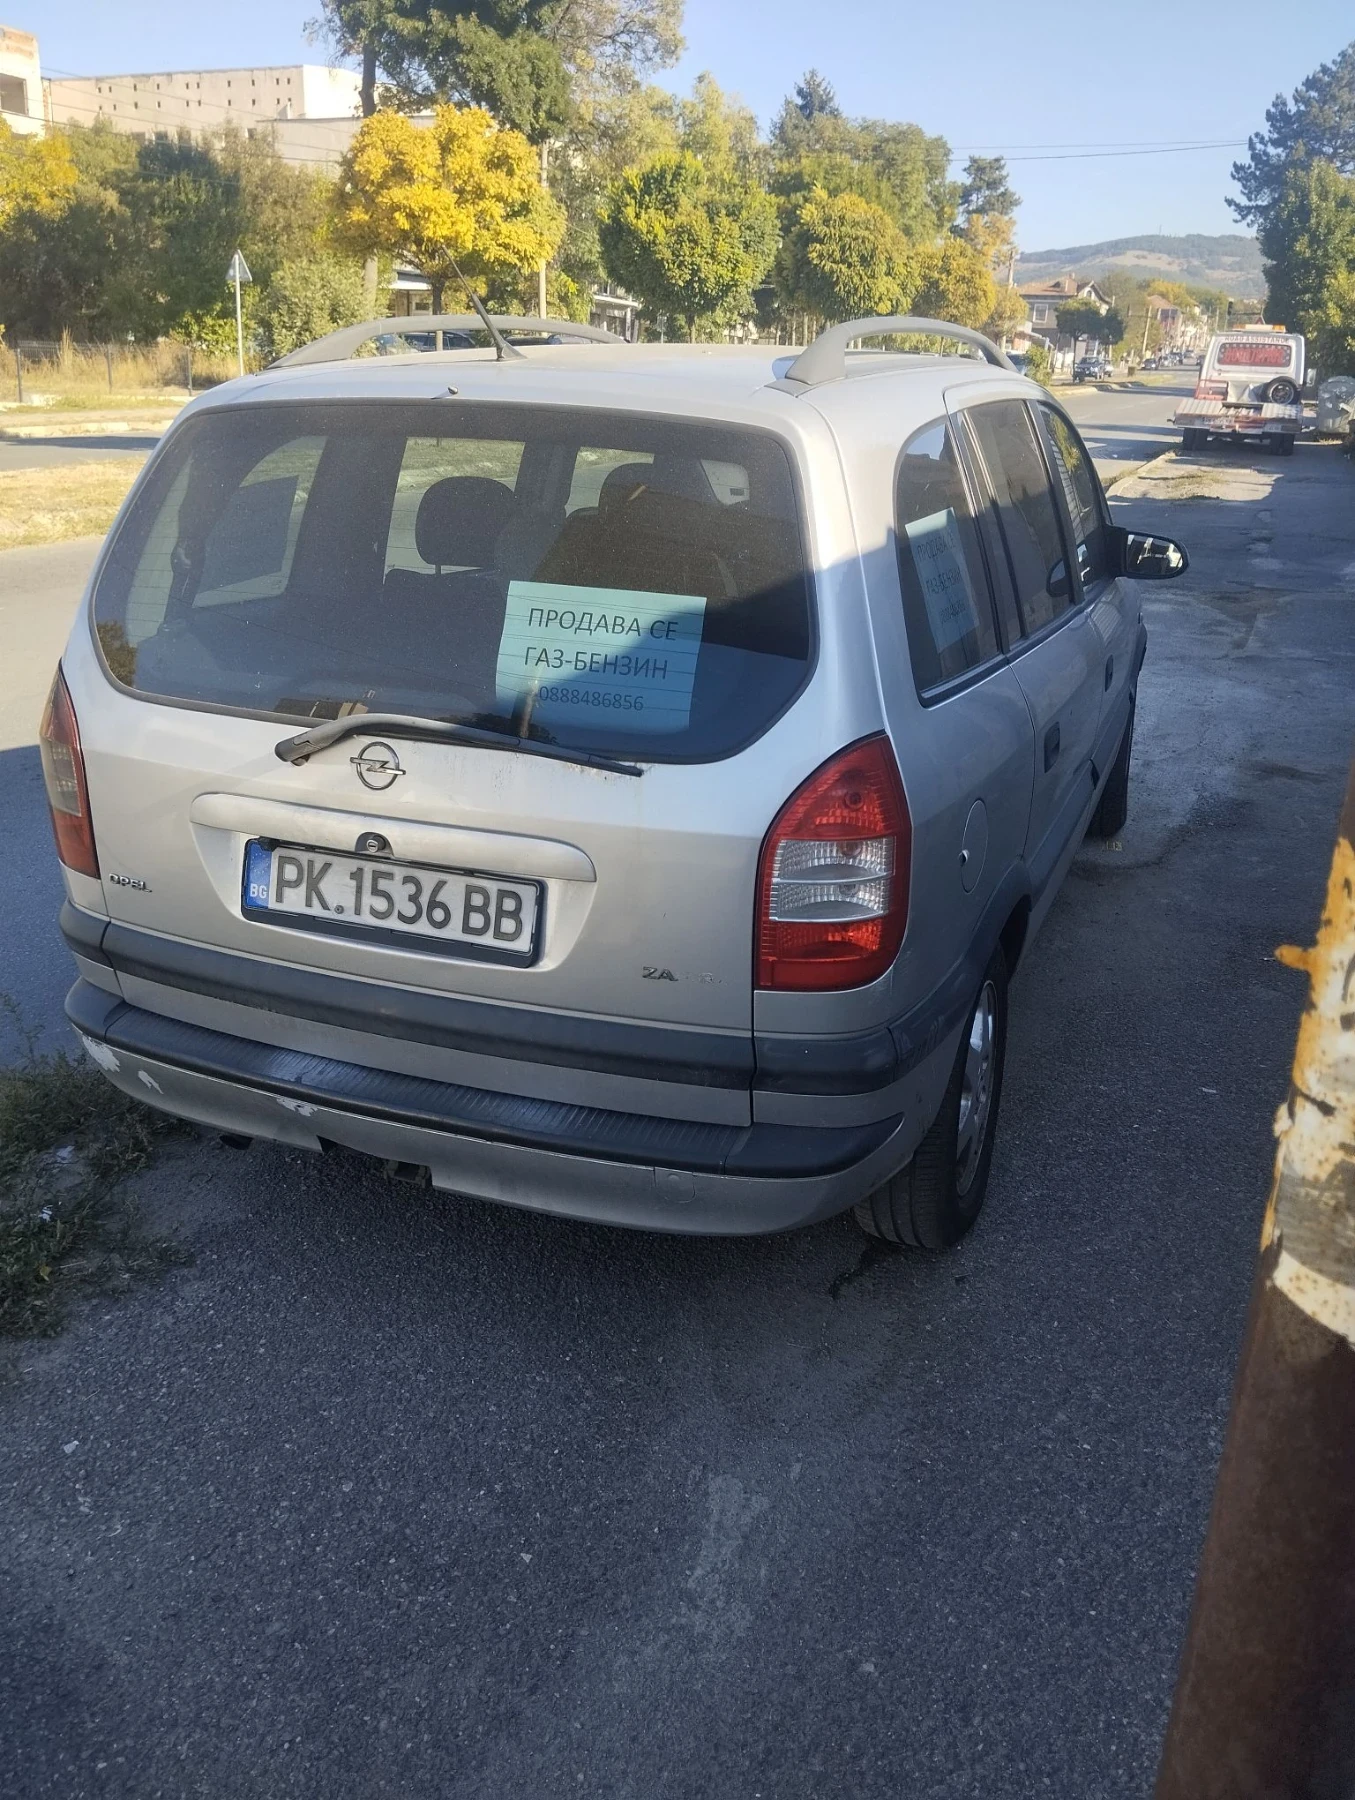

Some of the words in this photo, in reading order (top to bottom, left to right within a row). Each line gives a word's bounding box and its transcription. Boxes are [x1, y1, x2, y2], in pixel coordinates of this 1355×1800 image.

[528, 607, 641, 637] ПРОДАВА
[650, 620, 679, 641] СЕ
[524, 646, 668, 680] ГАЗ-БЕНЗИН
[539, 685, 644, 712] 0888486856
[109, 873, 153, 893] OPEL
[250, 883, 268, 899] BG
[462, 884, 523, 942] BB
